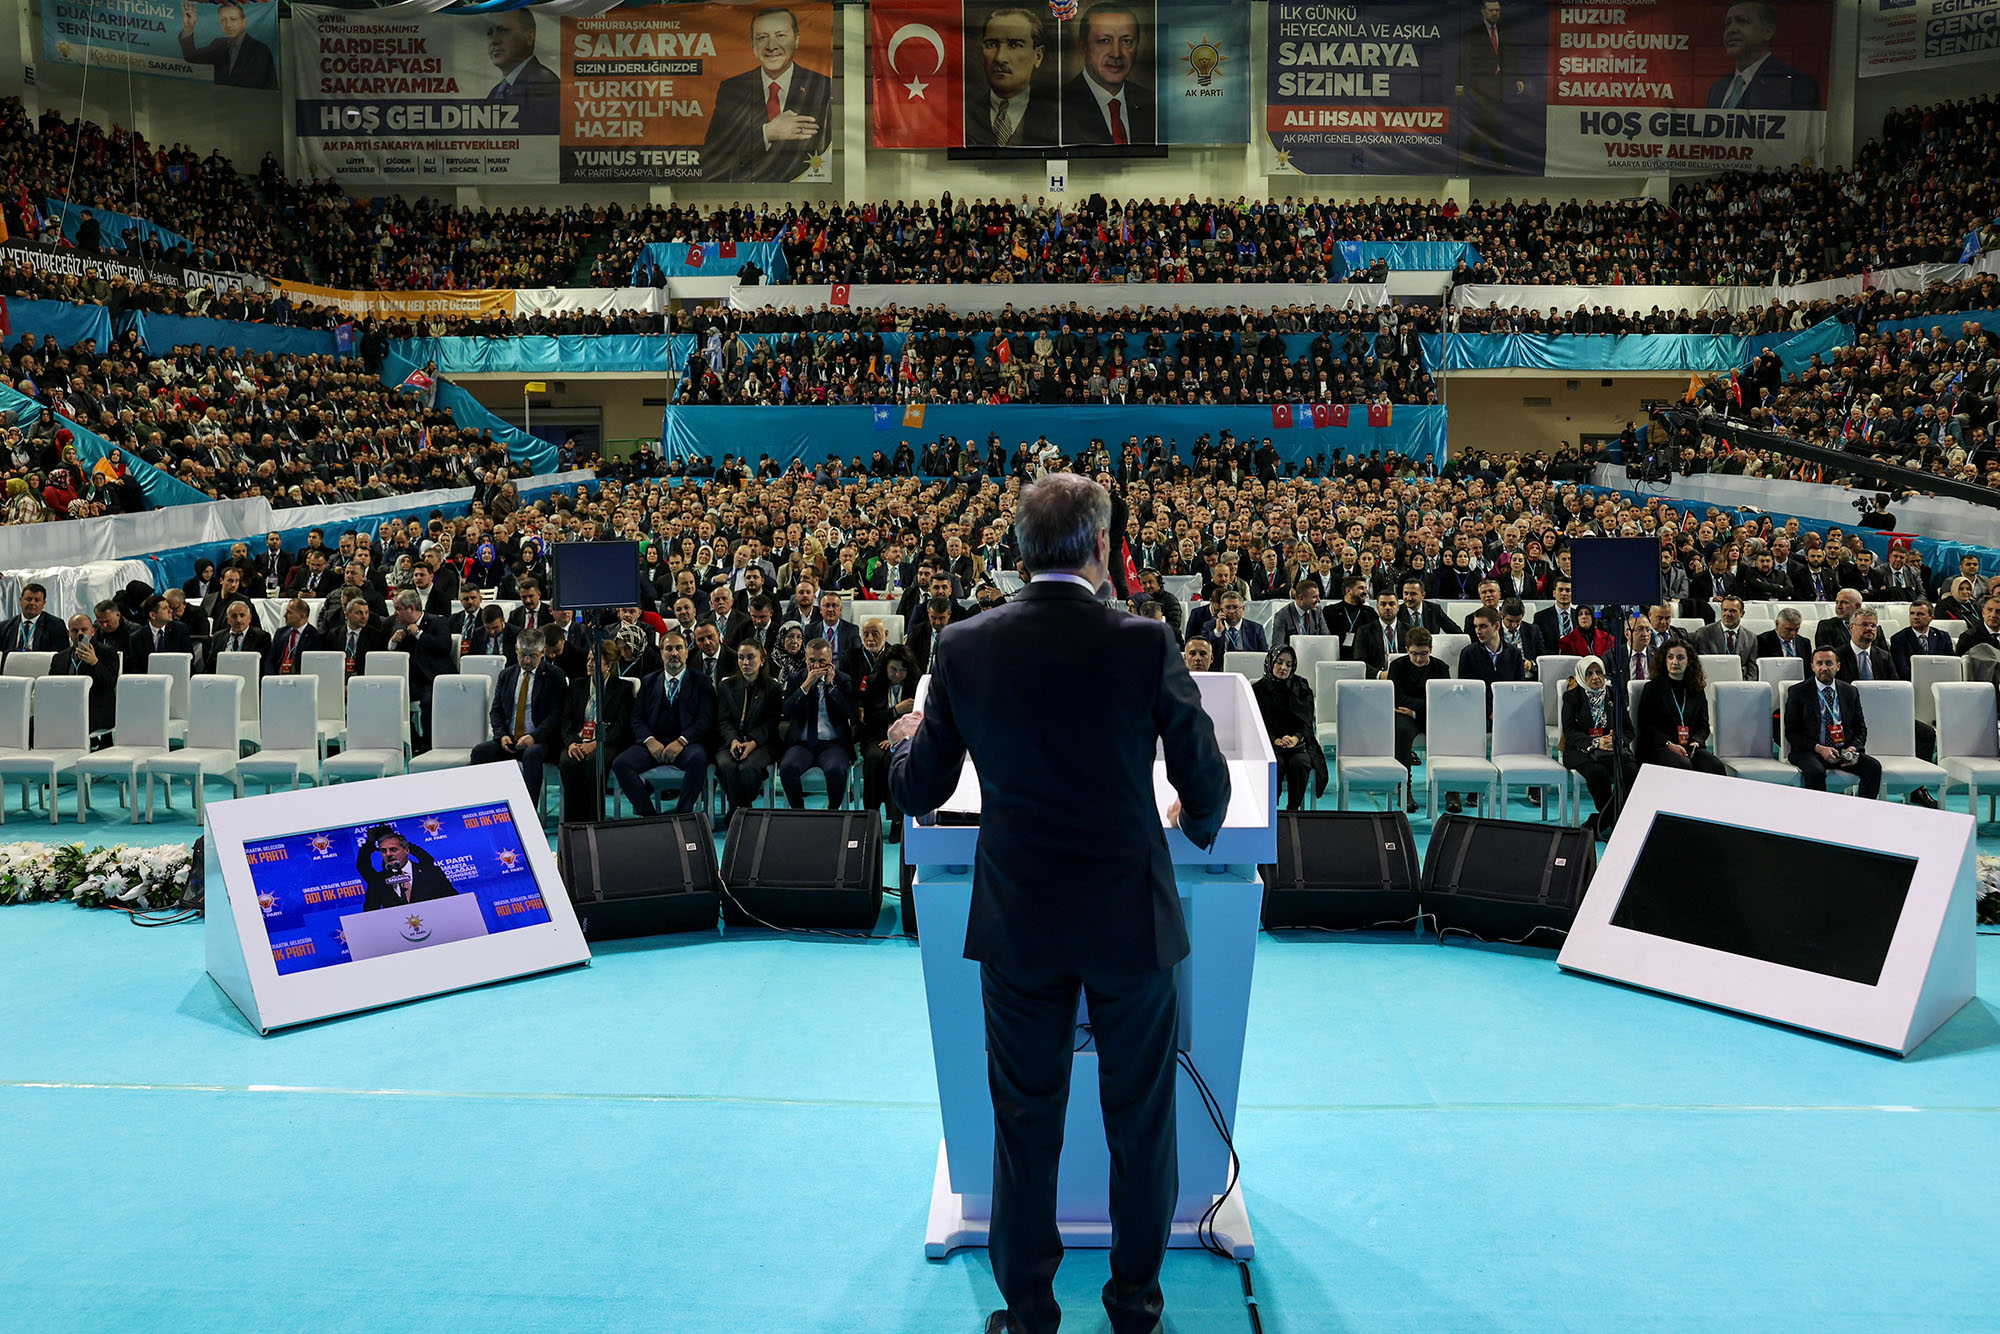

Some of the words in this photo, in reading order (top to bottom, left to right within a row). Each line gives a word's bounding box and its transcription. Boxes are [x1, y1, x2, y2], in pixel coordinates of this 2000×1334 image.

[318, 15, 346, 23] SAYIN
[1280, 4, 1302, 20] İLK
[1305, 4, 1357, 21] GÜNKÜ
[1560, 8, 1626, 24] HUZUR
[318, 25, 420, 35] CUMHURBAŞKANIMIZ
[576, 20, 680, 31] CUMHURBAŞKANIMIZ
[1280, 24, 1367, 38] HEYECANLA
[1370, 24, 1390, 38] VE
[1392, 24, 1440, 40] AŞKLA
[320, 38, 427, 56] KARDEŞLİK
[574, 32, 717, 58] SAKARYA
[1560, 30, 1690, 50] BULDUĞUNUZ
[1926, 29, 2000, 58] SENİN
[1278, 42, 1420, 67] SAKARYA
[25, 66, 34, 80] E
[148, 61, 193, 73] SAKARYA
[1559, 54, 1648, 76] ŞEHRİMİZ
[320, 77, 460, 94] SAKARYAMIZA
[1185, 89, 1197, 97] AK
[1200, 88, 1224, 97] PARTİ
[1278, 72, 1390, 97] SİZİNLE
[320, 105, 381, 135] HOŞ
[386, 104, 520, 130] GELDİNİZ
[1284, 110, 1314, 126] ALİ
[1318, 110, 1377, 127] İHSAN
[1380, 111, 1443, 128] YAVUZ
[1580, 111, 1642, 141] HOŞ
[1648, 112, 1786, 140] GELDİNİZ
[574, 120, 644, 138] HAZIR
[323, 141, 338, 151] AK
[339, 138, 371, 151] PARTİ
[373, 141, 424, 151] SAKARYA
[426, 138, 520, 150] MİLLETVEKİLLERİ
[1282, 134, 1296, 144] AK
[1298, 134, 1322, 144] PARTİ
[1324, 134, 1354, 144] GENEL
[1355, 135, 1392, 145] BAŞKAN
[1394, 136, 1443, 145] YARDIMCISI
[574, 151, 637, 166] YUNUS
[640, 150, 700, 166] TEVER
[1604, 142, 1663, 158] YUSUF
[1666, 145, 1754, 160] ALEMDAR
[1608, 160, 1640, 168] SAKARYA
[1642, 160, 1686, 168] BÜYÜKŞEHİR
[574, 169, 587, 178] AK
[588, 168, 612, 178] PARTİ
[614, 169, 654, 178] SAKARYA
[656, 168, 663, 178] İL
[664, 169, 703, 178] BAŞKANI
[1051, 176, 1063, 187] H
[377, 299, 406, 312] OLMAK
[408, 299, 426, 311] HER
[354, 826, 368, 834] AK
[464, 818, 480, 830] ADI
[480, 816, 493, 827] AK
[260, 849, 288, 863] PARTİ
[446, 854, 473, 865] PARTİ
[444, 864, 477, 876] OLAĞAN
[304, 892, 322, 904] ADI
[322, 890, 336, 902] AK
[337, 884, 366, 900] PARTİ
[496, 904, 512, 918] ADI
[512, 902, 526, 914] AK
[286, 942, 317, 959] PARTİ
